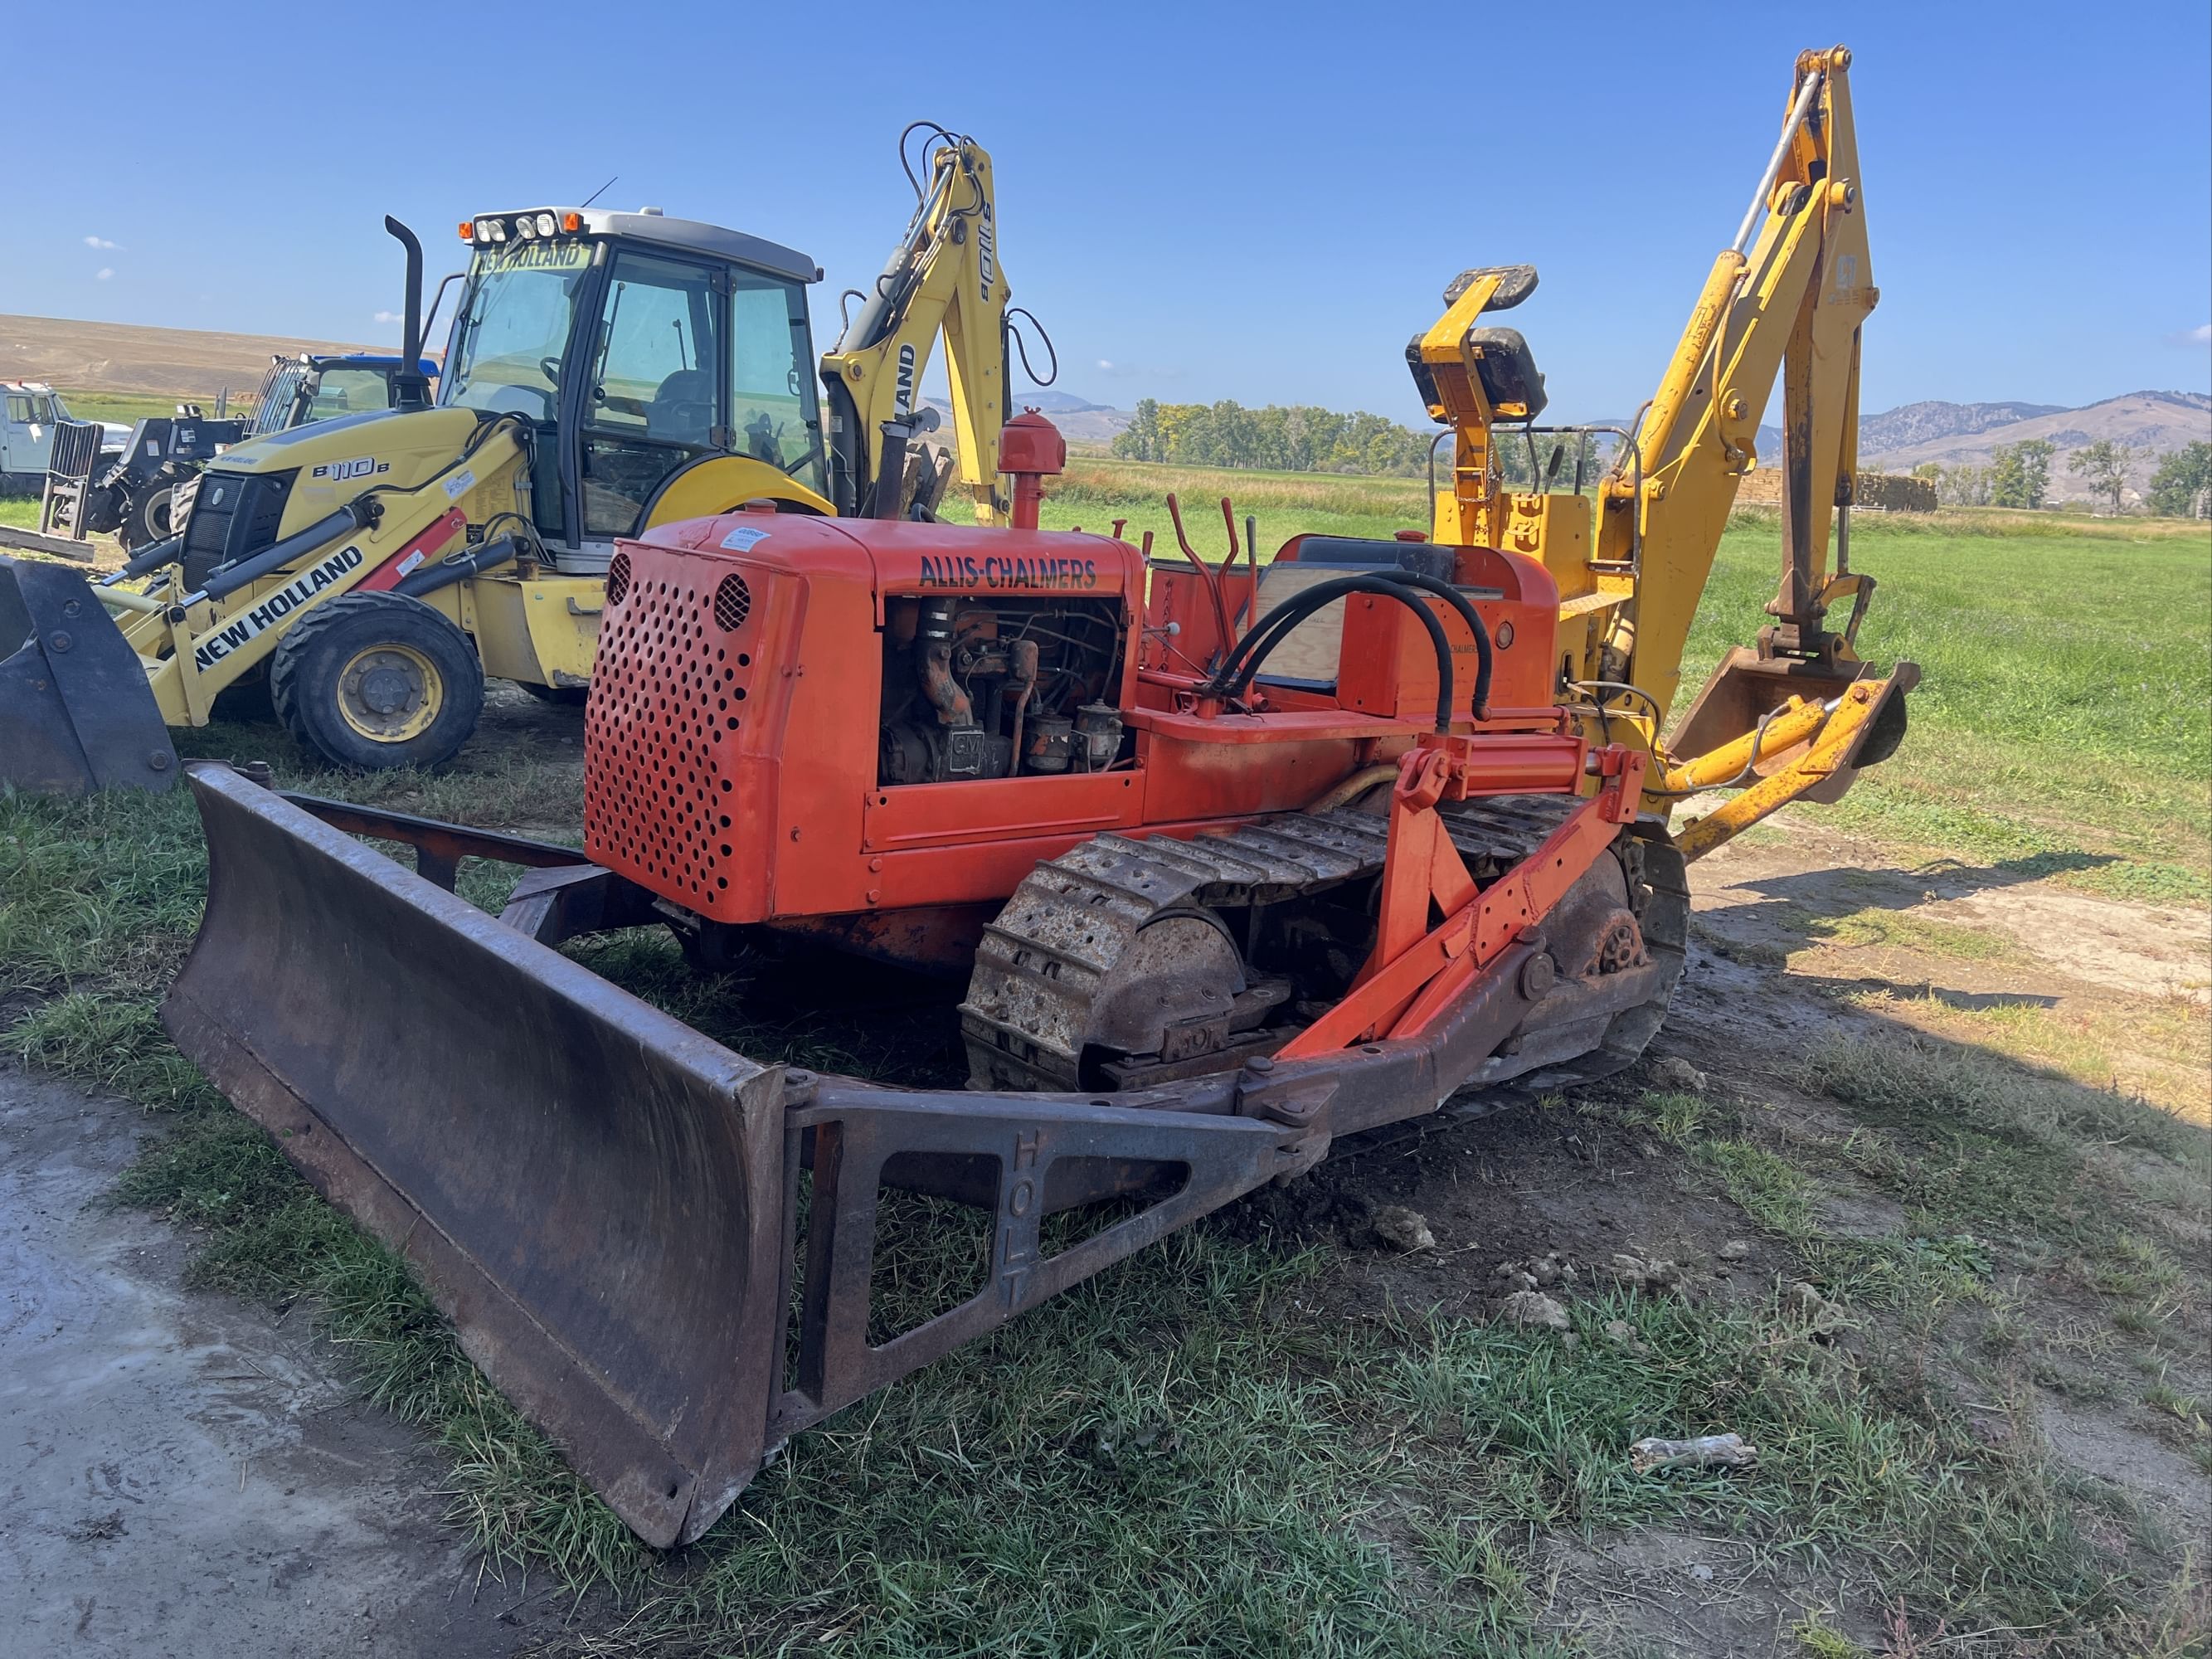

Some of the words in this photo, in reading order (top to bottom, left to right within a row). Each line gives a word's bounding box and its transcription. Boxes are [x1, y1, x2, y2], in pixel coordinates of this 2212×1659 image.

[194, 620, 250, 674] NEW
[249, 545, 362, 630] HOLLAND
[919, 556, 1096, 590] ALLIS-CHALMERS
[1002, 1128, 1040, 1309] HOLT
